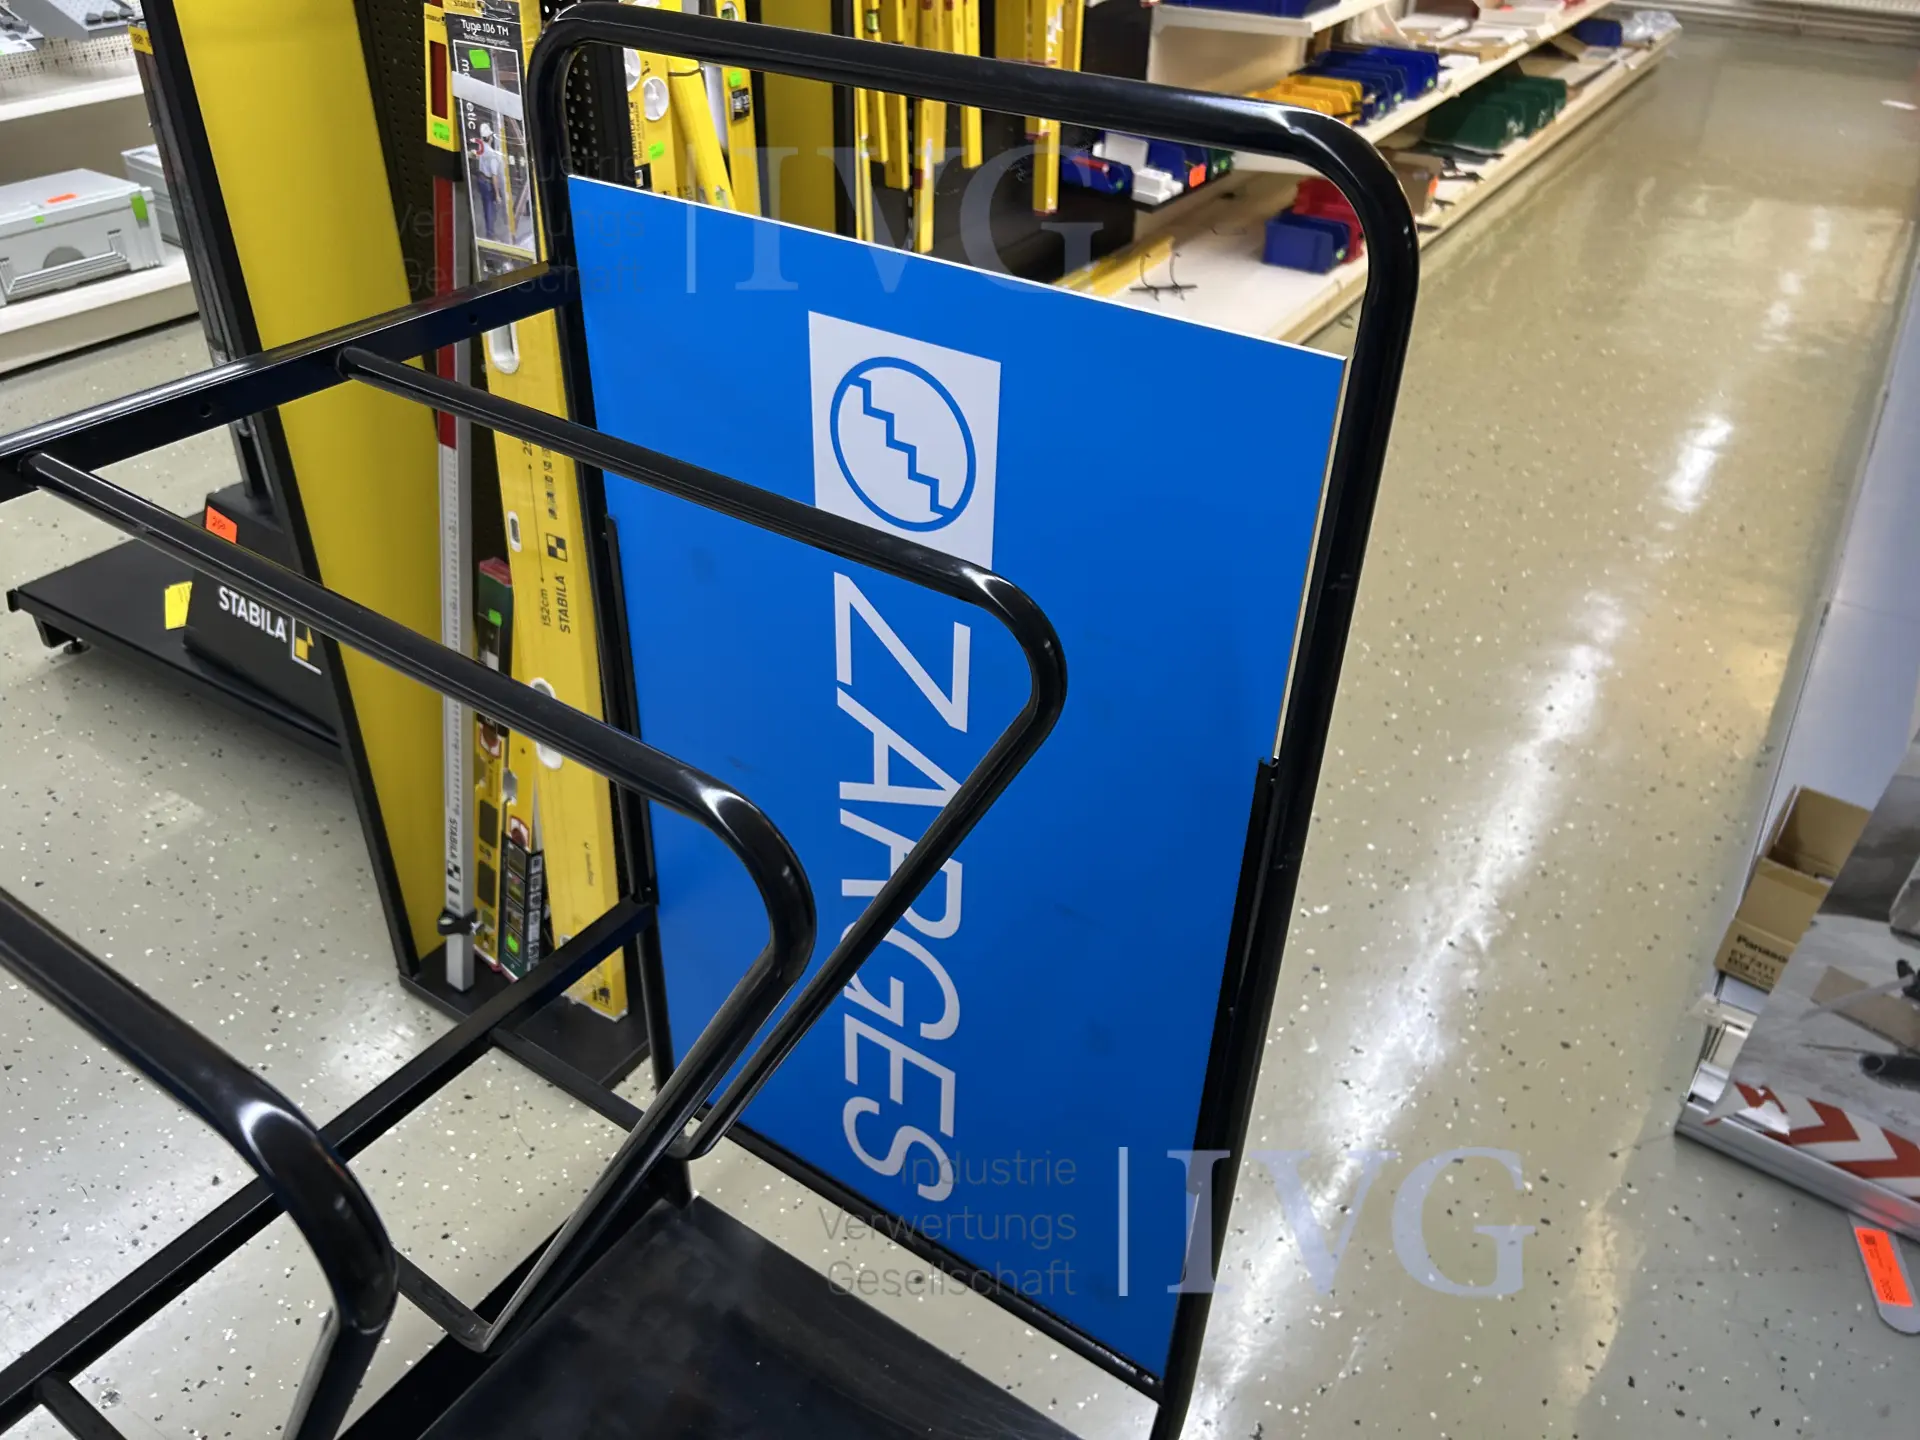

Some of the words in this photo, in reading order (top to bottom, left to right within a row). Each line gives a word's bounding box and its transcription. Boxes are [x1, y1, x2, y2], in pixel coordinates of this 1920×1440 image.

[460, 18, 482, 35] Type
[482, 23, 496, 34] 106
[496, 25, 509, 36] TM
[218, 585, 287, 643] STABILA
[541, 588, 551, 627] 152cm
[556, 574, 571, 634] STABILA
[448, 816, 458, 859] STABILA
[834, 571, 971, 1203] ZARGES
